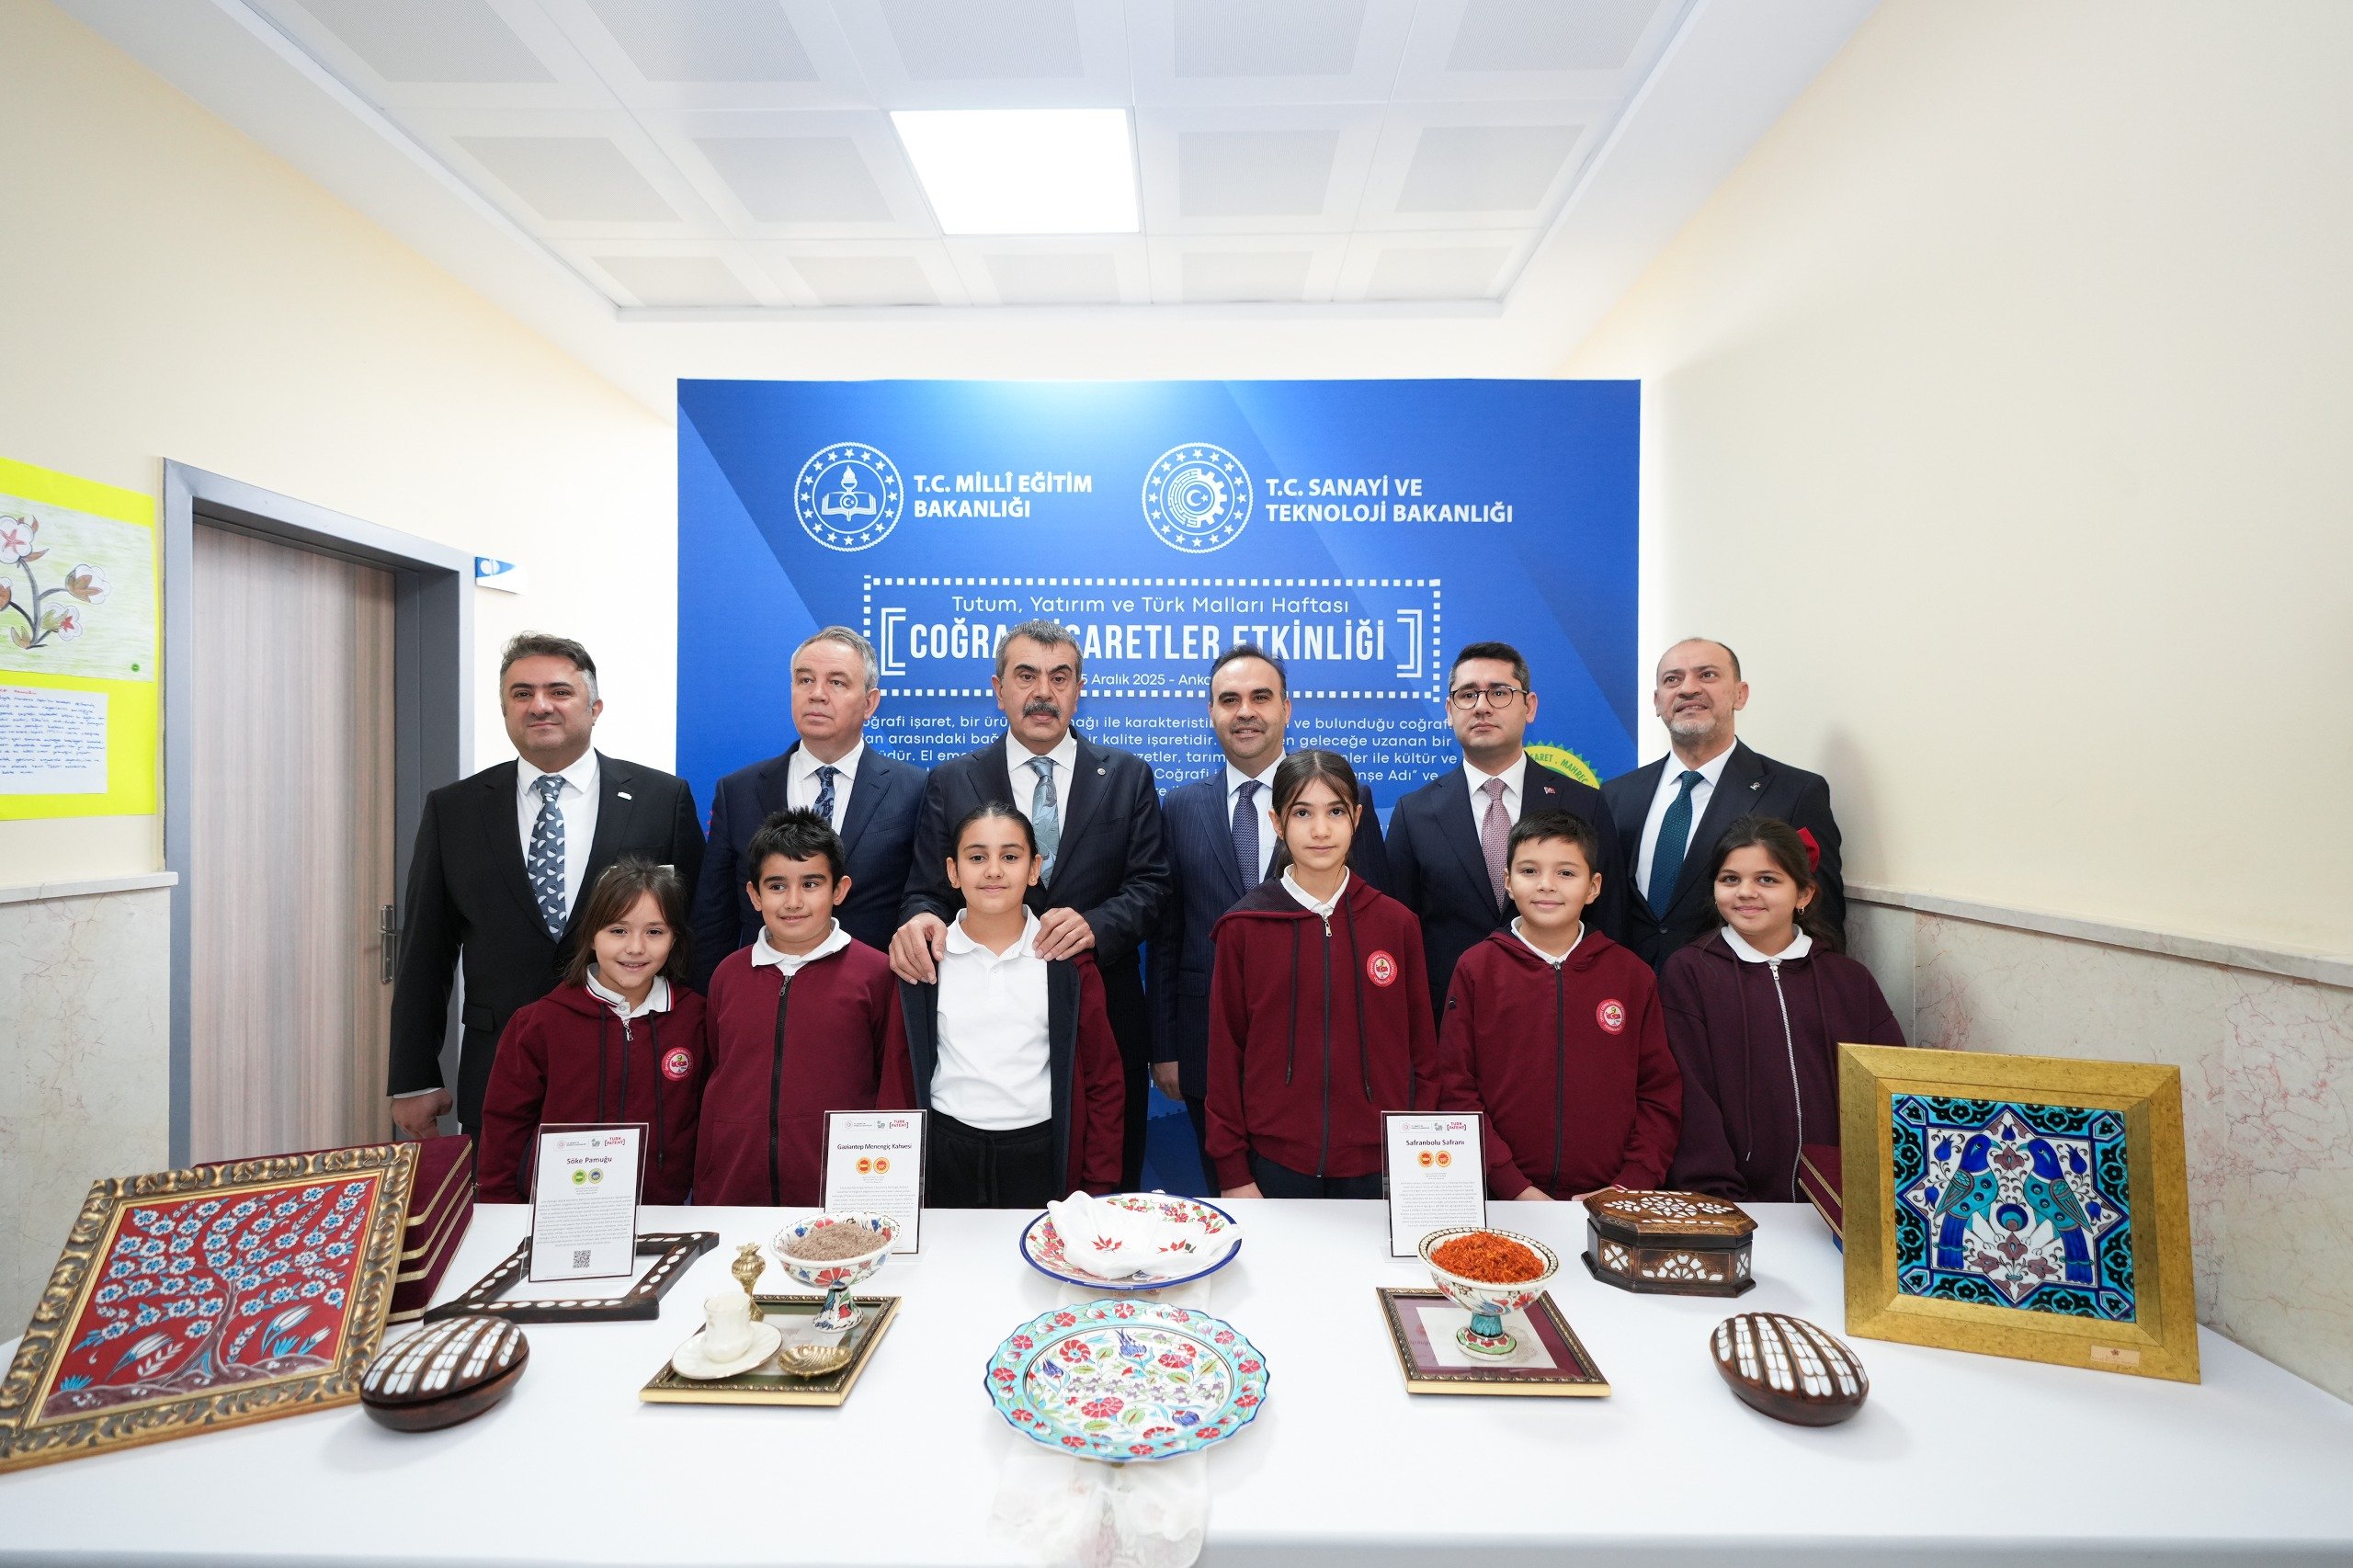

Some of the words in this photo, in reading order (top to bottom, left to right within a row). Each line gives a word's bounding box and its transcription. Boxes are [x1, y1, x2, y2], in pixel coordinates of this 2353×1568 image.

[913, 474, 951, 494] T.C.
[1018, 471, 1093, 494] EĞİTİM
[1265, 478, 1304, 497] T.C.
[1308, 474, 1389, 497] SANAYİ
[1394, 478, 1423, 496] VE
[914, 496, 1030, 518] BAKANLIĞI
[1265, 500, 1386, 522] TEKNOLOJİ
[1392, 501, 1513, 523] BAKANLIĞI
[951, 596, 1023, 614] Tutum,
[1029, 596, 1105, 612] Yatırım
[1111, 599, 1135, 613] ve
[1141, 596, 1185, 613] Türk
[1192, 597, 1264, 613] Malları
[1272, 597, 1348, 614] Haftası
[909, 618, 1039, 659] COĞRA
[1054, 619, 1220, 660] ARETLER
[1233, 619, 1384, 660] ETKİNLİĞİ
[1091, 673, 1130, 686] Aralık
[1132, 673, 1165, 686] 2025
[1178, 674, 1211, 685] Anka
[863, 716, 905, 729] oğrafi
[910, 716, 955, 730] işaret,
[960, 715, 981, 727] bir
[984, 717, 1008, 727] ürü
[1104, 716, 1121, 728] ile
[1293, 720, 1311, 729] ve
[1315, 717, 1394, 733] bulunduğu
[1399, 717, 1451, 732] coğraf
[888, 733, 966, 744] arasındaki
[1103, 733, 1142, 745] kalite
[1147, 733, 1217, 748] işaretidir.
[1299, 734, 1368, 749] geleceğe
[1372, 737, 1427, 747] uzanan
[1432, 735, 1452, 747] bir
[920, 749, 933, 761] El
[1372, 752, 1390, 764] ile
[1394, 752, 1438, 765] kültür
[1440, 755, 1458, 765] ve
[1530, 754, 1554, 764] ARET
[585, 1155, 612, 1164] Pamuğu
